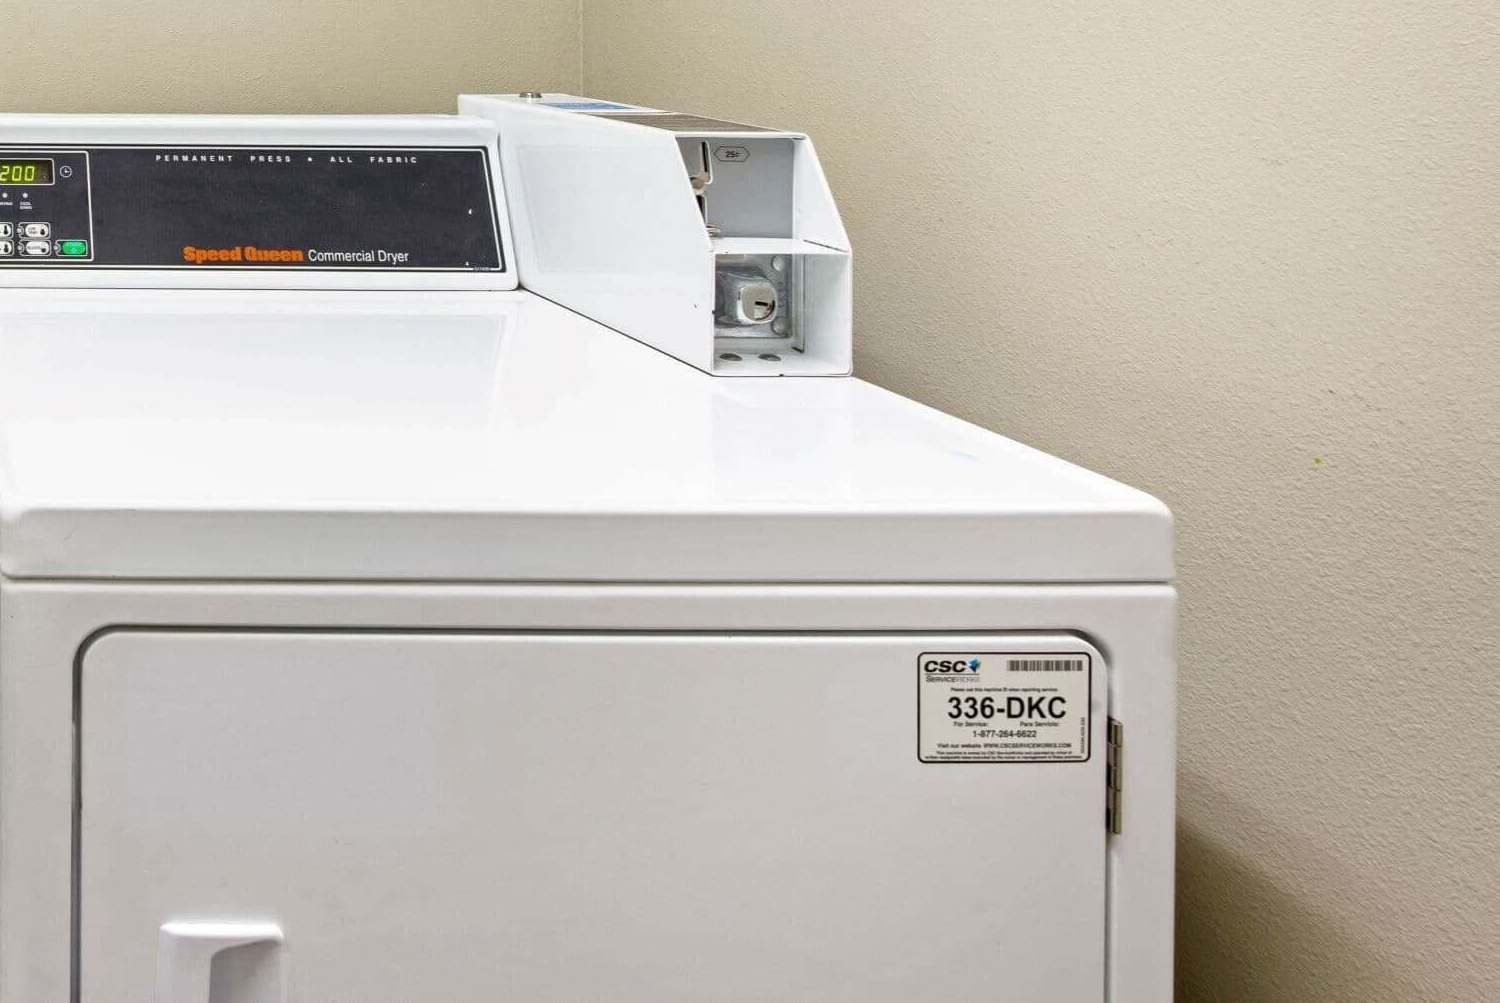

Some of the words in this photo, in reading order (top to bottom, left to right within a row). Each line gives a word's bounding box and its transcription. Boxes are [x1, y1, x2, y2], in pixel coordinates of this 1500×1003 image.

[250, 155, 291, 163] PRESS
[0, 165, 35, 181] 200
[183, 245, 242, 264] Speed
[244, 246, 303, 262] Queen
[308, 249, 375, 262] Commercial
[379, 250, 409, 264] Dryer
[924, 660, 967, 673] CSC
[948, 696, 1067, 719] 336-DKC
[973, 730, 1037, 738] 1-877-264-6622
